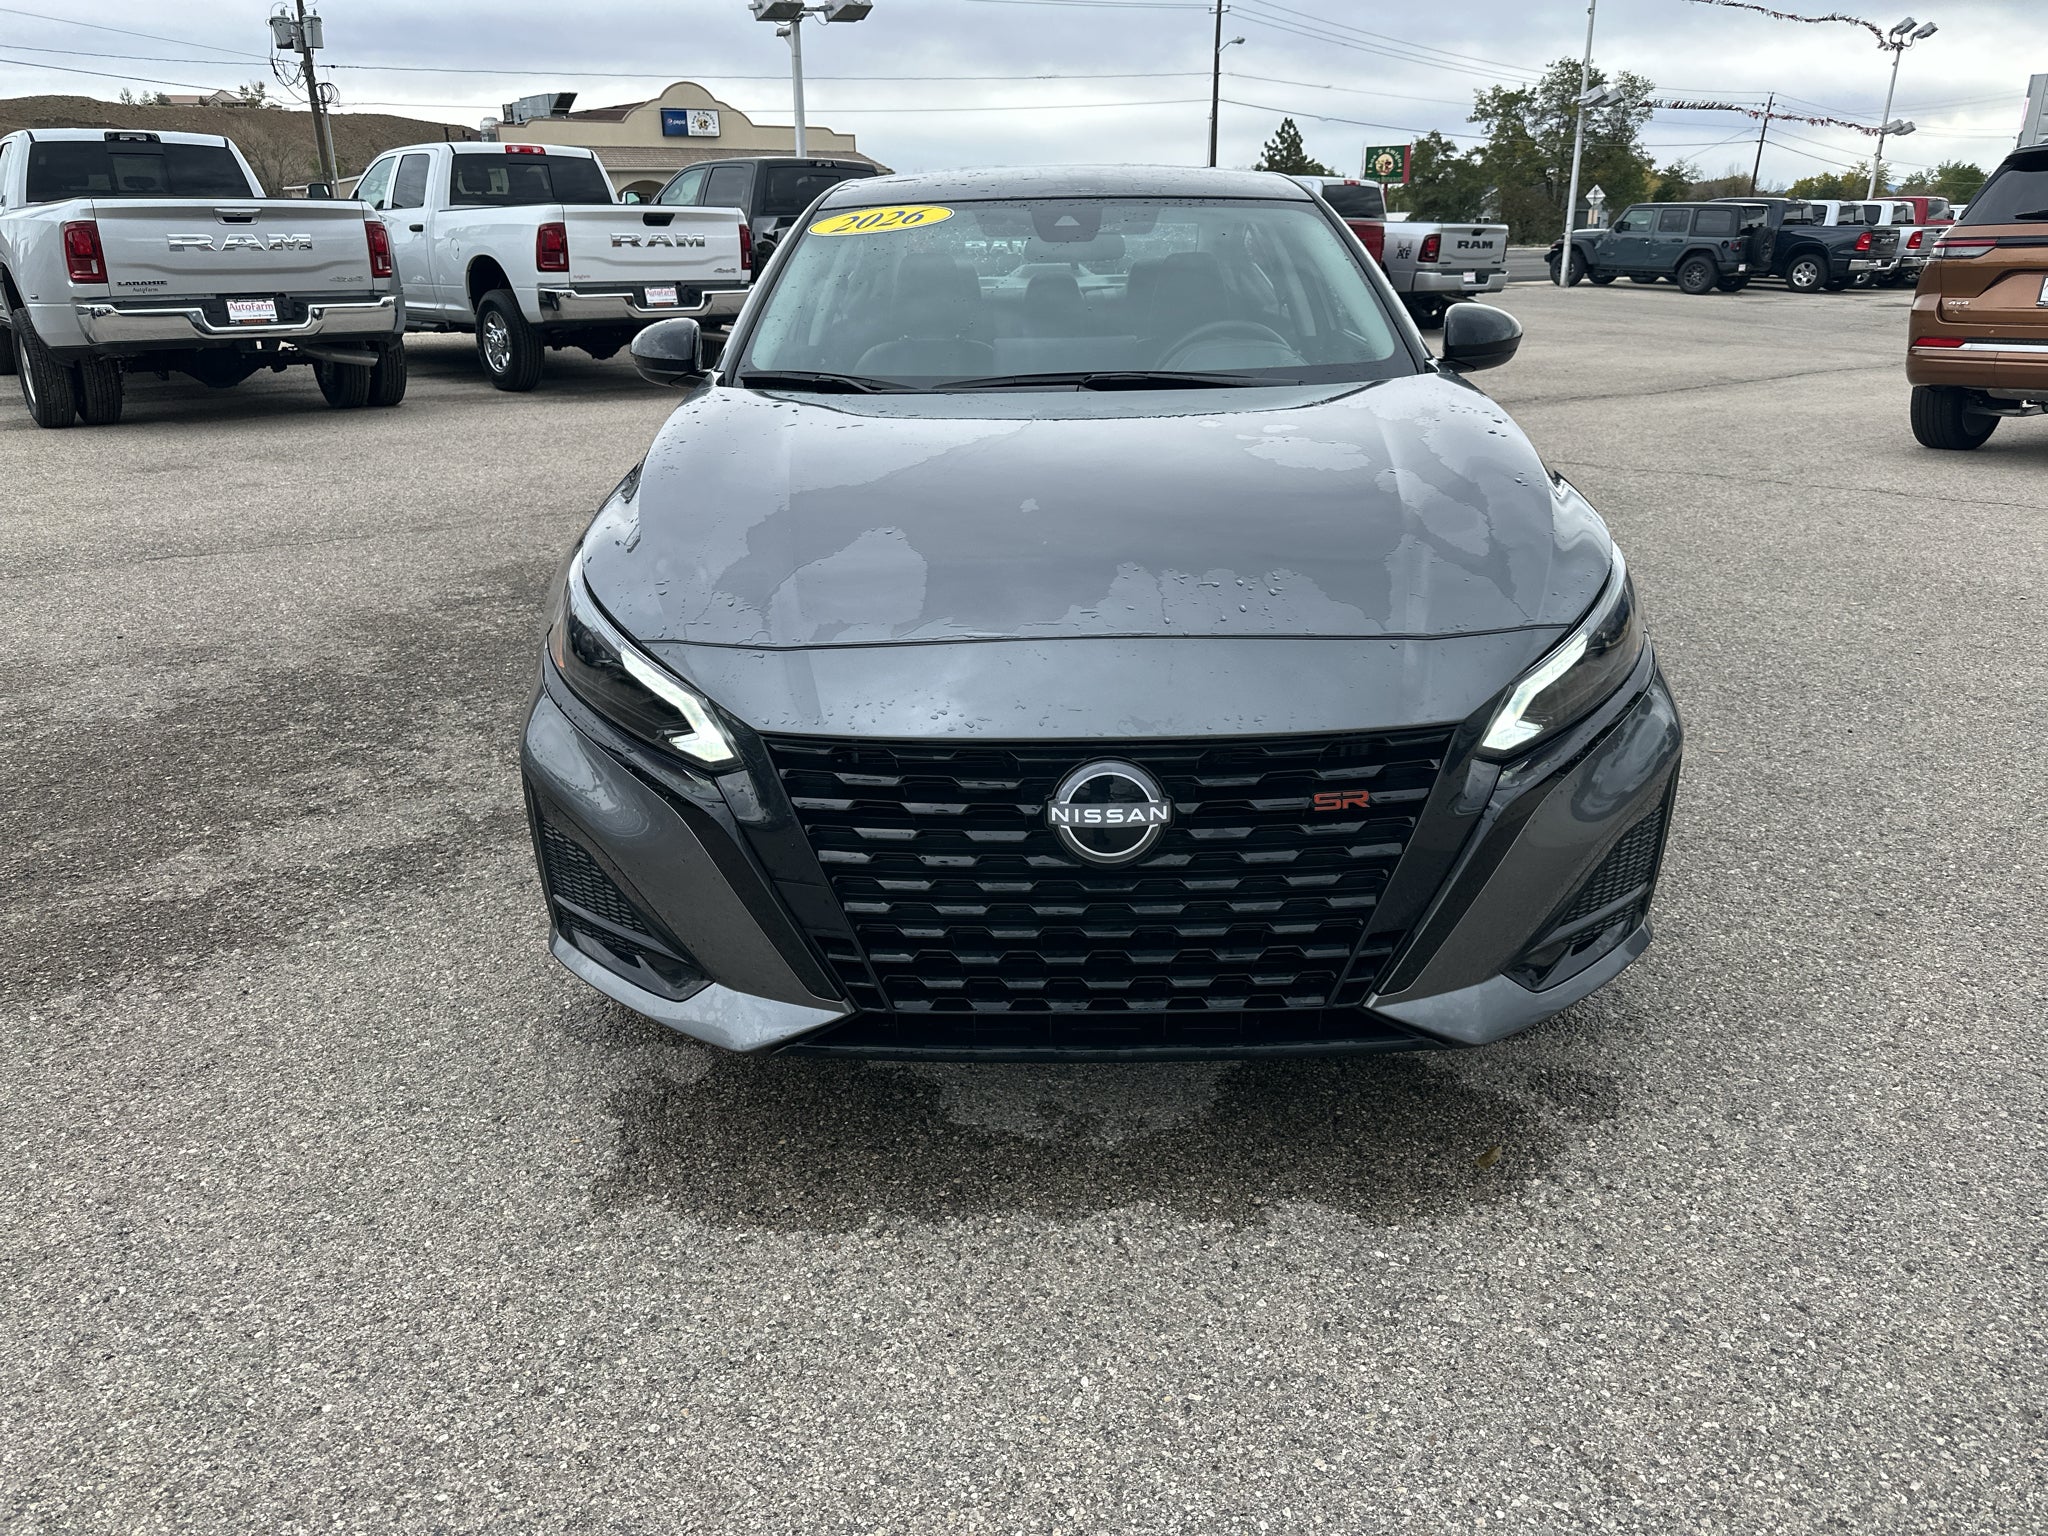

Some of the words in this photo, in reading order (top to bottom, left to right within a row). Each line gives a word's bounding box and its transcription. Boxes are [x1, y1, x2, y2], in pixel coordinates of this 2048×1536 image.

[830, 208, 933, 233] 2026
[167, 233, 313, 251] RAM
[610, 233, 705, 247] RAM
[1457, 240, 1493, 249] RAM
[646, 288, 677, 298] AutoFarm
[229, 302, 275, 312] AutoFarm
[1313, 790, 1370, 812] SR
[1051, 804, 1169, 824] NISSAN
